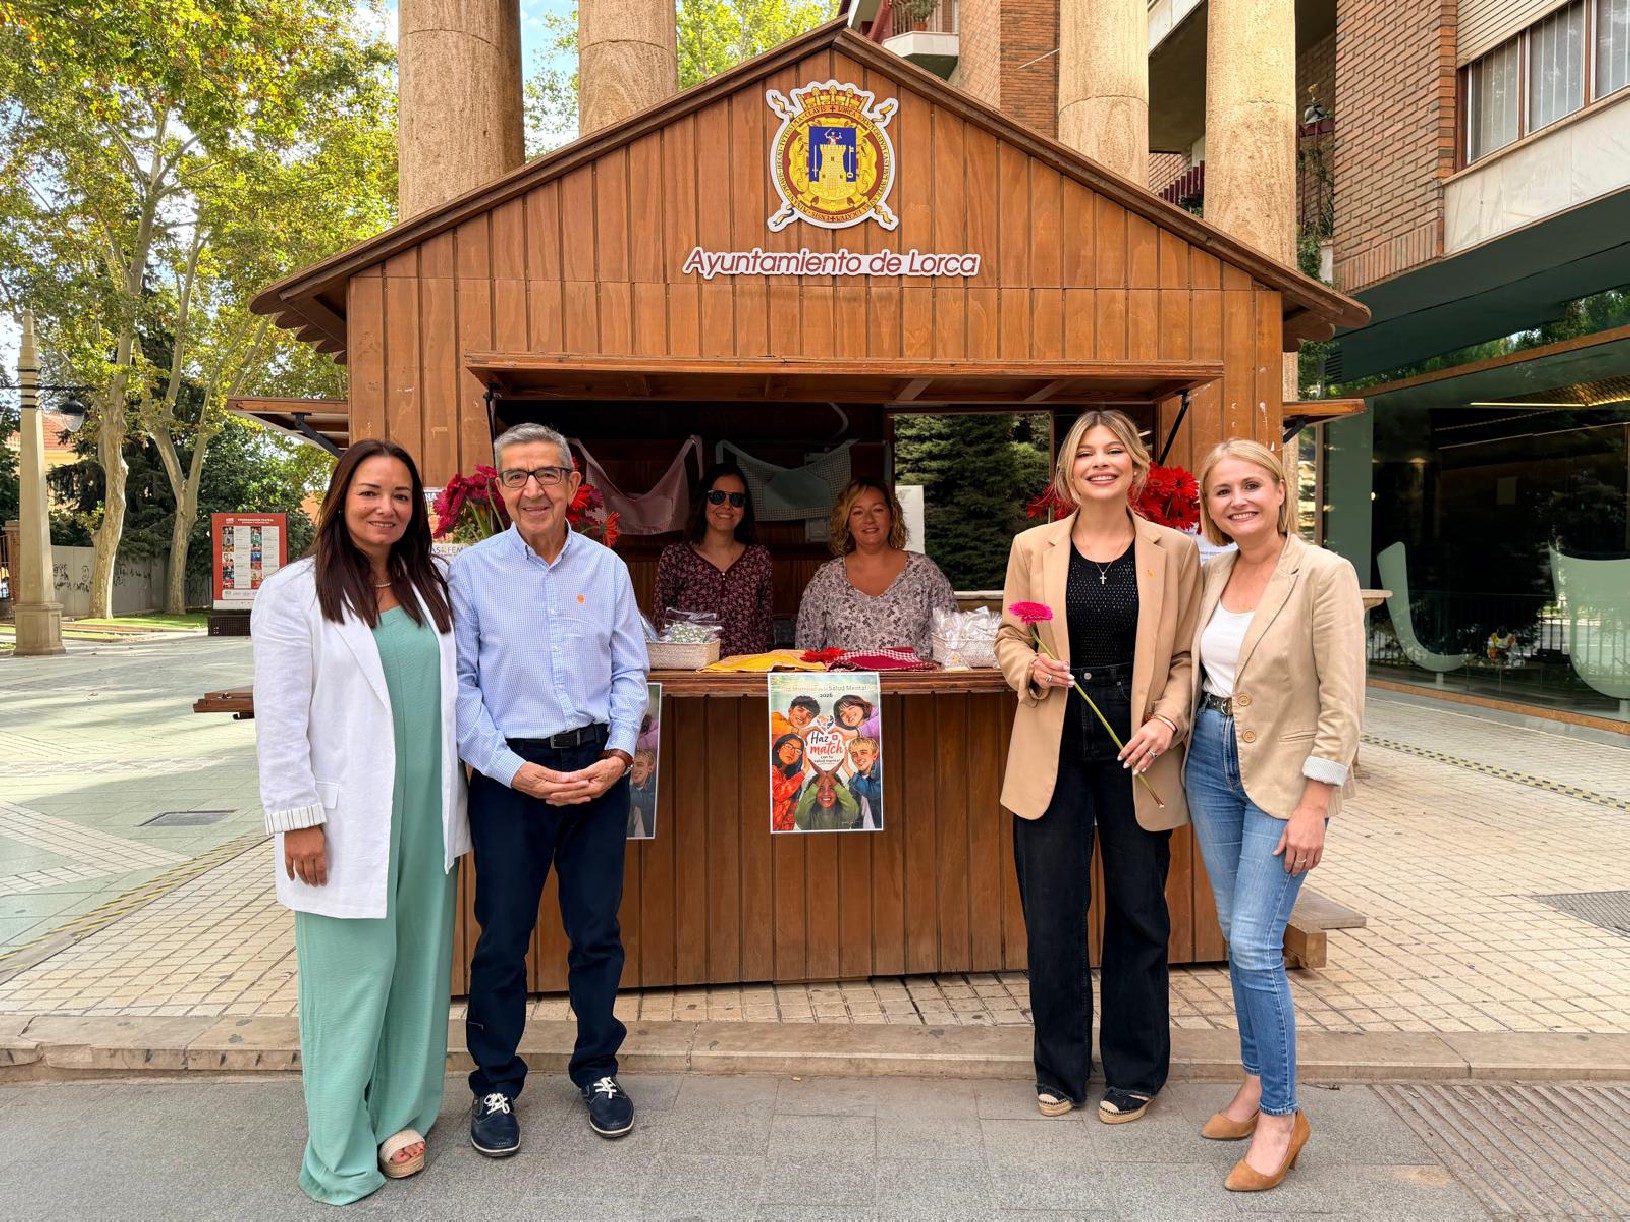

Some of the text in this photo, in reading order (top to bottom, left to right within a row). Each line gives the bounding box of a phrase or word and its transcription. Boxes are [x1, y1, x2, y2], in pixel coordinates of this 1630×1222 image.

[684, 249, 977, 277] Ayuntamiento de Lorca
[810, 732, 829, 744] Haz
[809, 739, 843, 755] match
